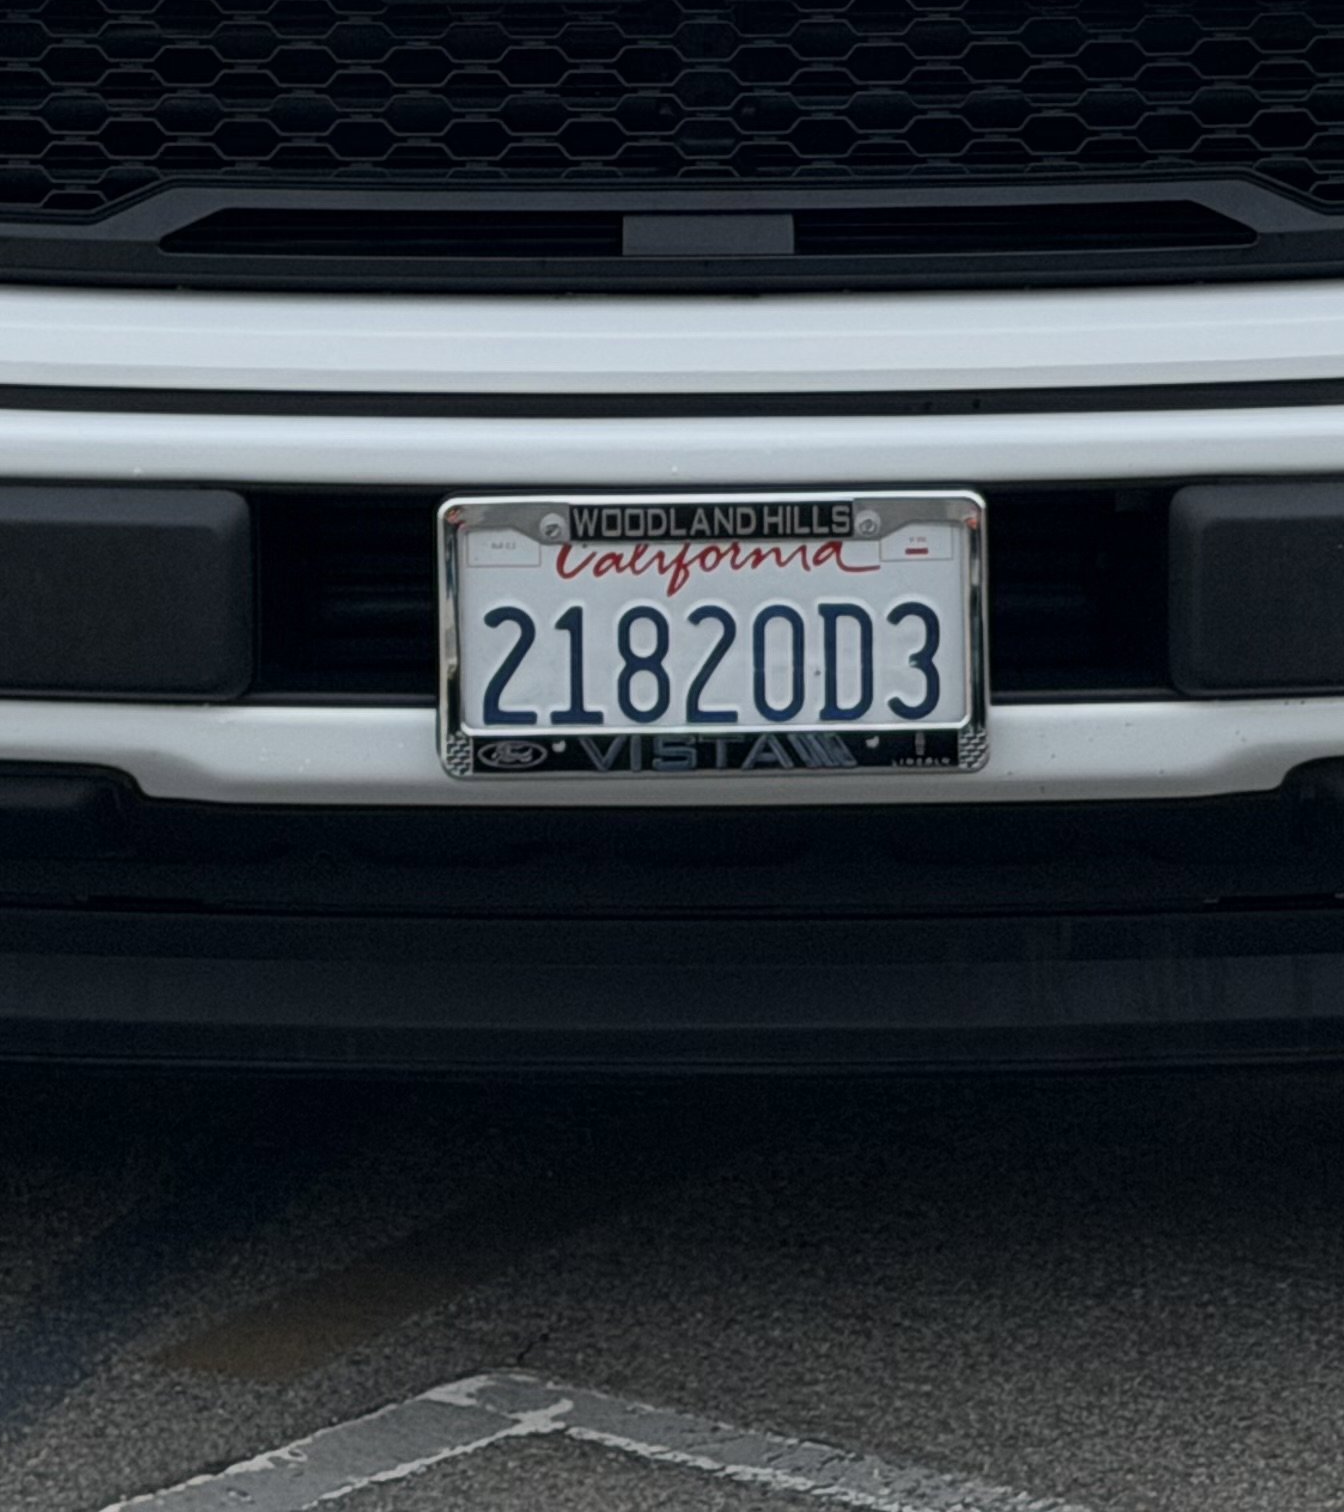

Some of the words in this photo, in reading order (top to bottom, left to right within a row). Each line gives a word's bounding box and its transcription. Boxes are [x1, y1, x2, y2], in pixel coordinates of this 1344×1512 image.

[572, 506, 757, 538] WOODLAND
[762, 504, 851, 535] HILLS
[555, 540, 881, 598] California
[482, 601, 941, 726] 21820D3
[578, 732, 802, 772] VISTA
